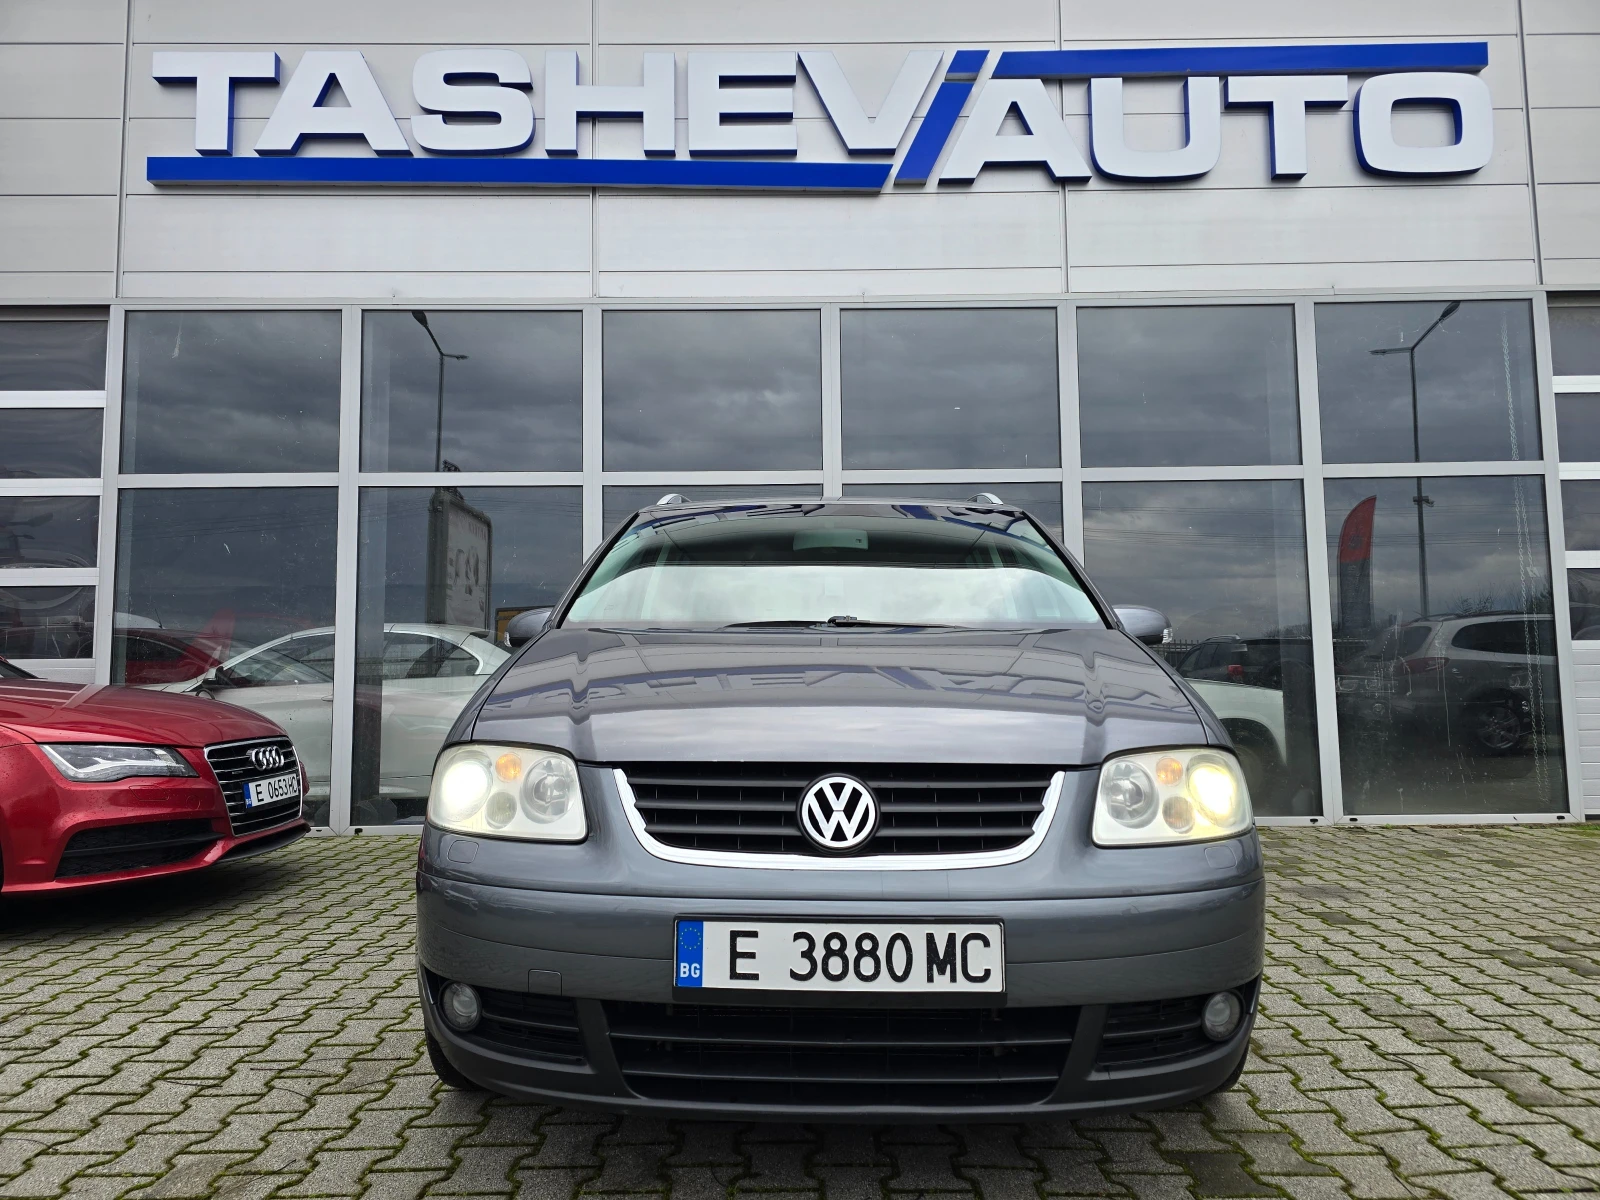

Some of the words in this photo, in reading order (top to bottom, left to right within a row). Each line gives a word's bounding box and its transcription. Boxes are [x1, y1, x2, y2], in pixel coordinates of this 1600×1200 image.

[152, 50, 944, 156] TASHEV
[936, 72, 1494, 182] AUTO
[255, 784, 265, 802] E
[680, 963, 700, 978] BG
[729, 930, 759, 980] E
[789, 931, 913, 983] 3880
[925, 932, 991, 984] MC
